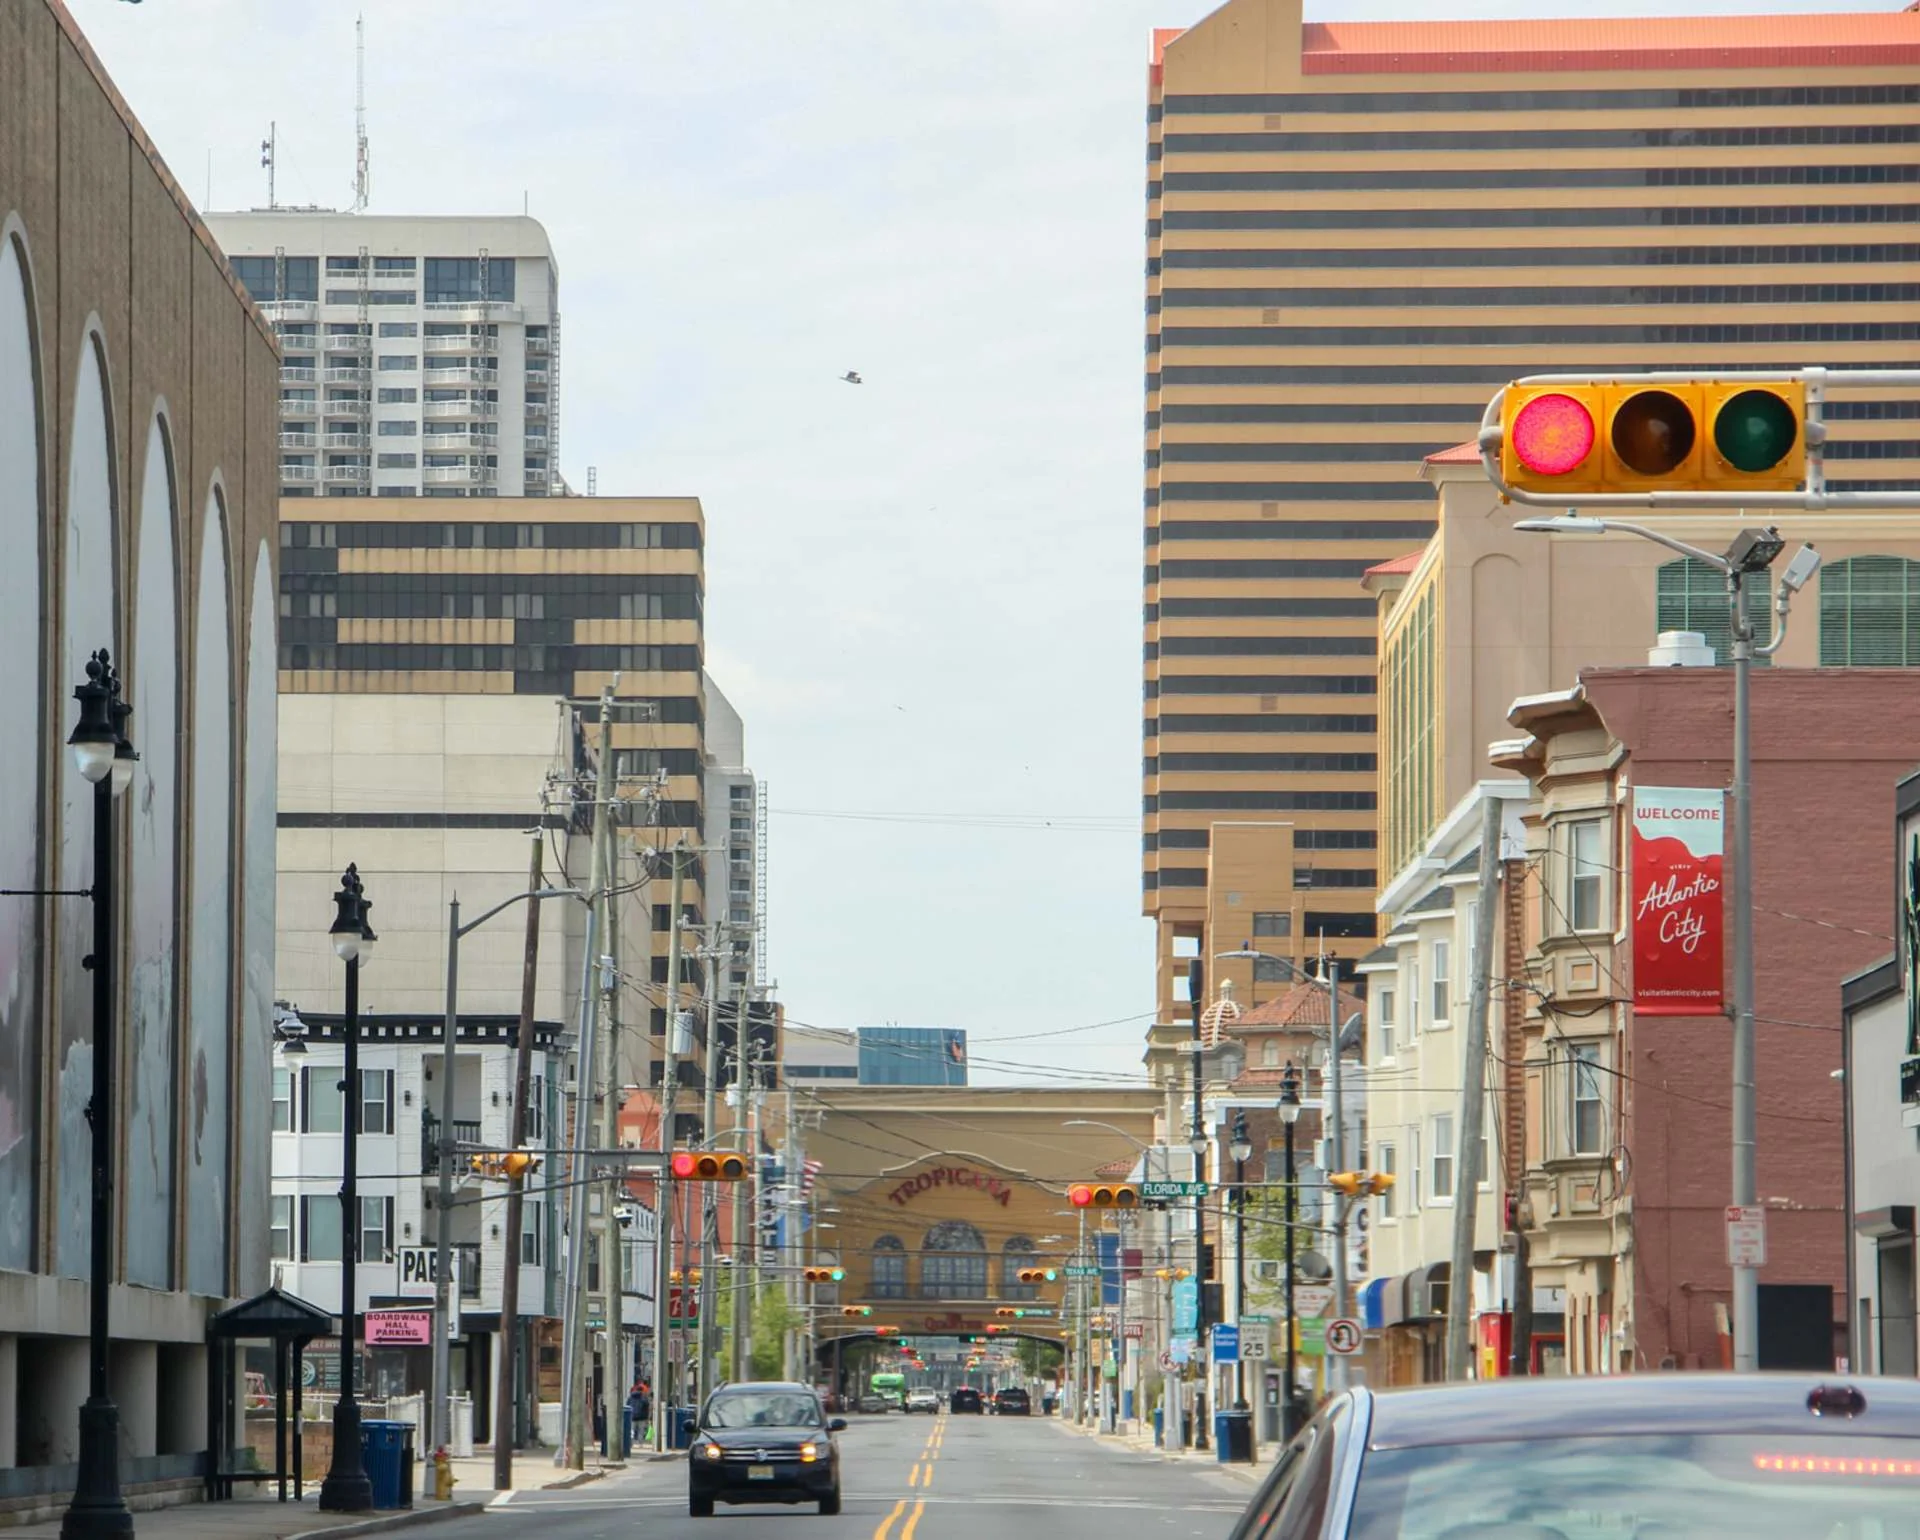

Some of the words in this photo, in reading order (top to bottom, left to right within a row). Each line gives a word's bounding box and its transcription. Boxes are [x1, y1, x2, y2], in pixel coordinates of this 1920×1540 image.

[1636, 807, 1719, 820] WELCOME
[1637, 872, 1719, 921] Atlantic
[1660, 908, 1706, 954] City
[1638, 989, 1720, 998] visitatlanticcity.com
[888, 1167, 1011, 1206] TROPICANA
[1143, 1183, 1182, 1195] FLORIDA
[375, 1329, 419, 1337] PARKING
[1243, 1342, 1265, 1357] 25
